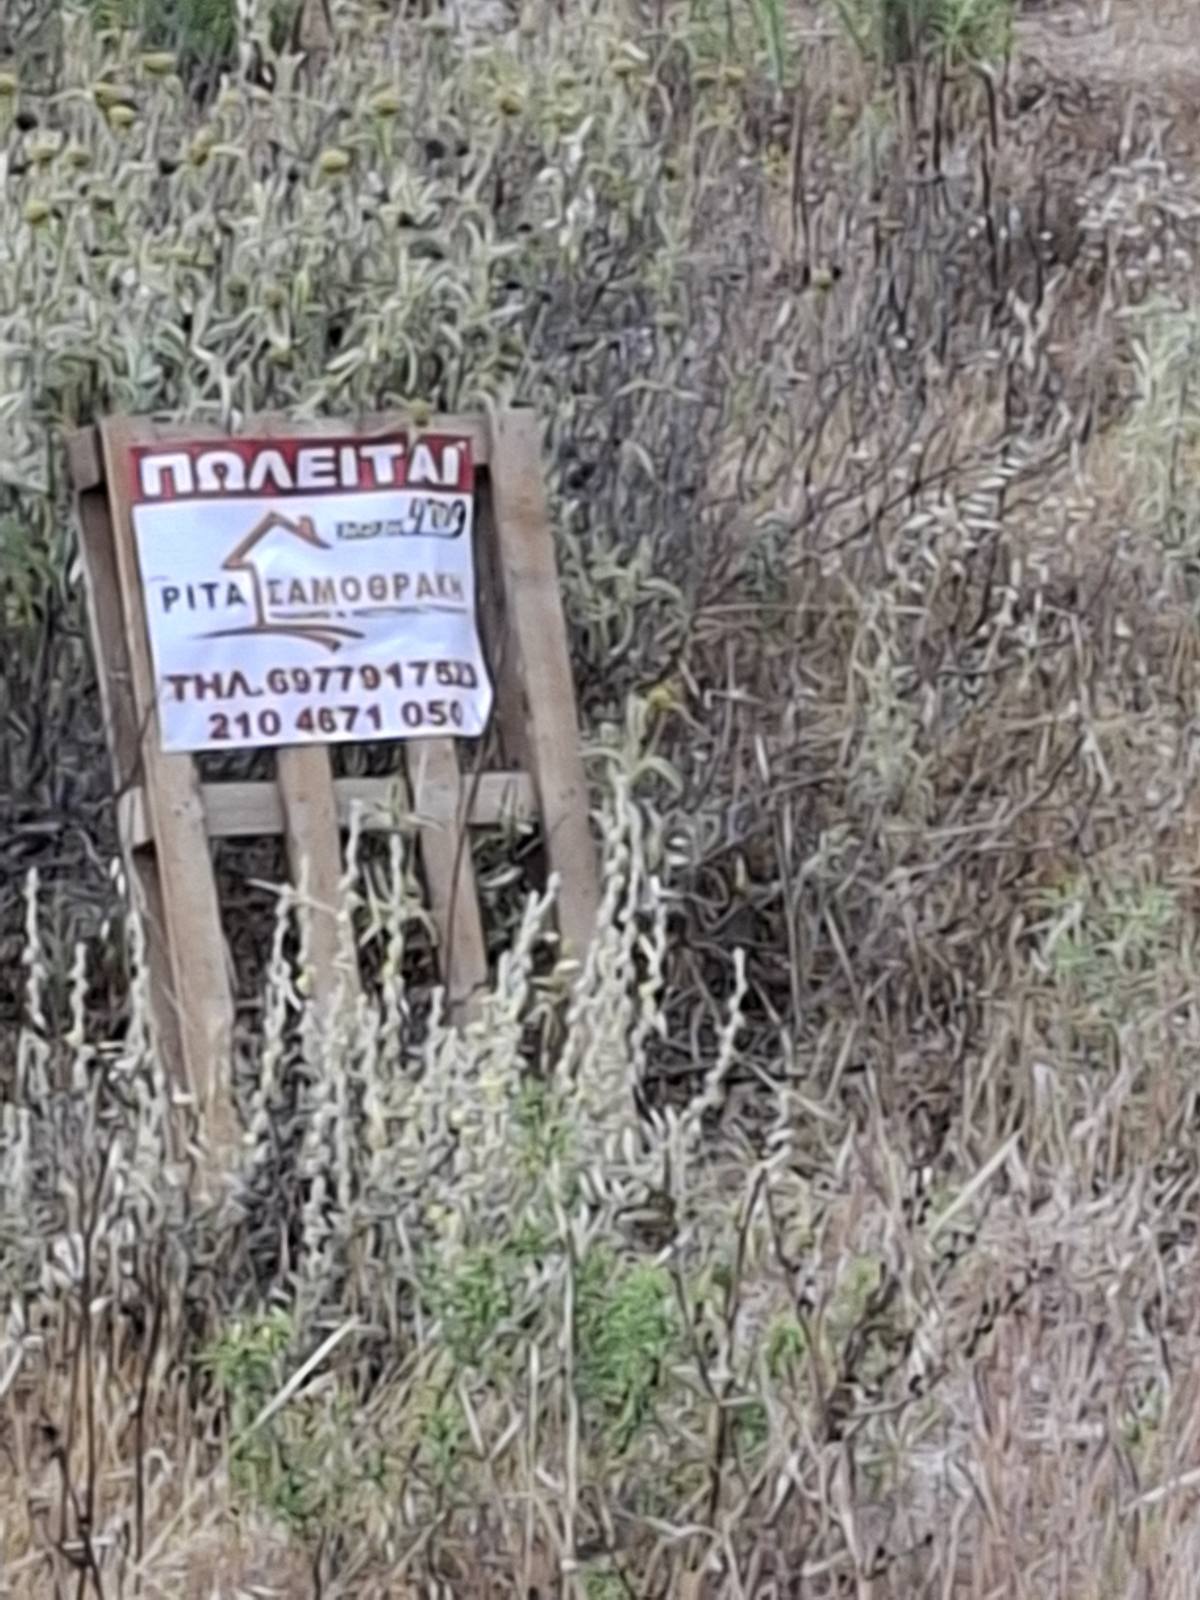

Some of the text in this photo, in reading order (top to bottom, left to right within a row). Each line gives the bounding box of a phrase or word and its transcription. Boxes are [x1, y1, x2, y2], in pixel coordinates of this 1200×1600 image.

[140, 443, 460, 497] ΠΩΛΕΙΤΑΙ
[161, 581, 247, 613] ΡΙΤΑ
[208, 708, 281, 740] 210
[295, 702, 382, 736] 4671
